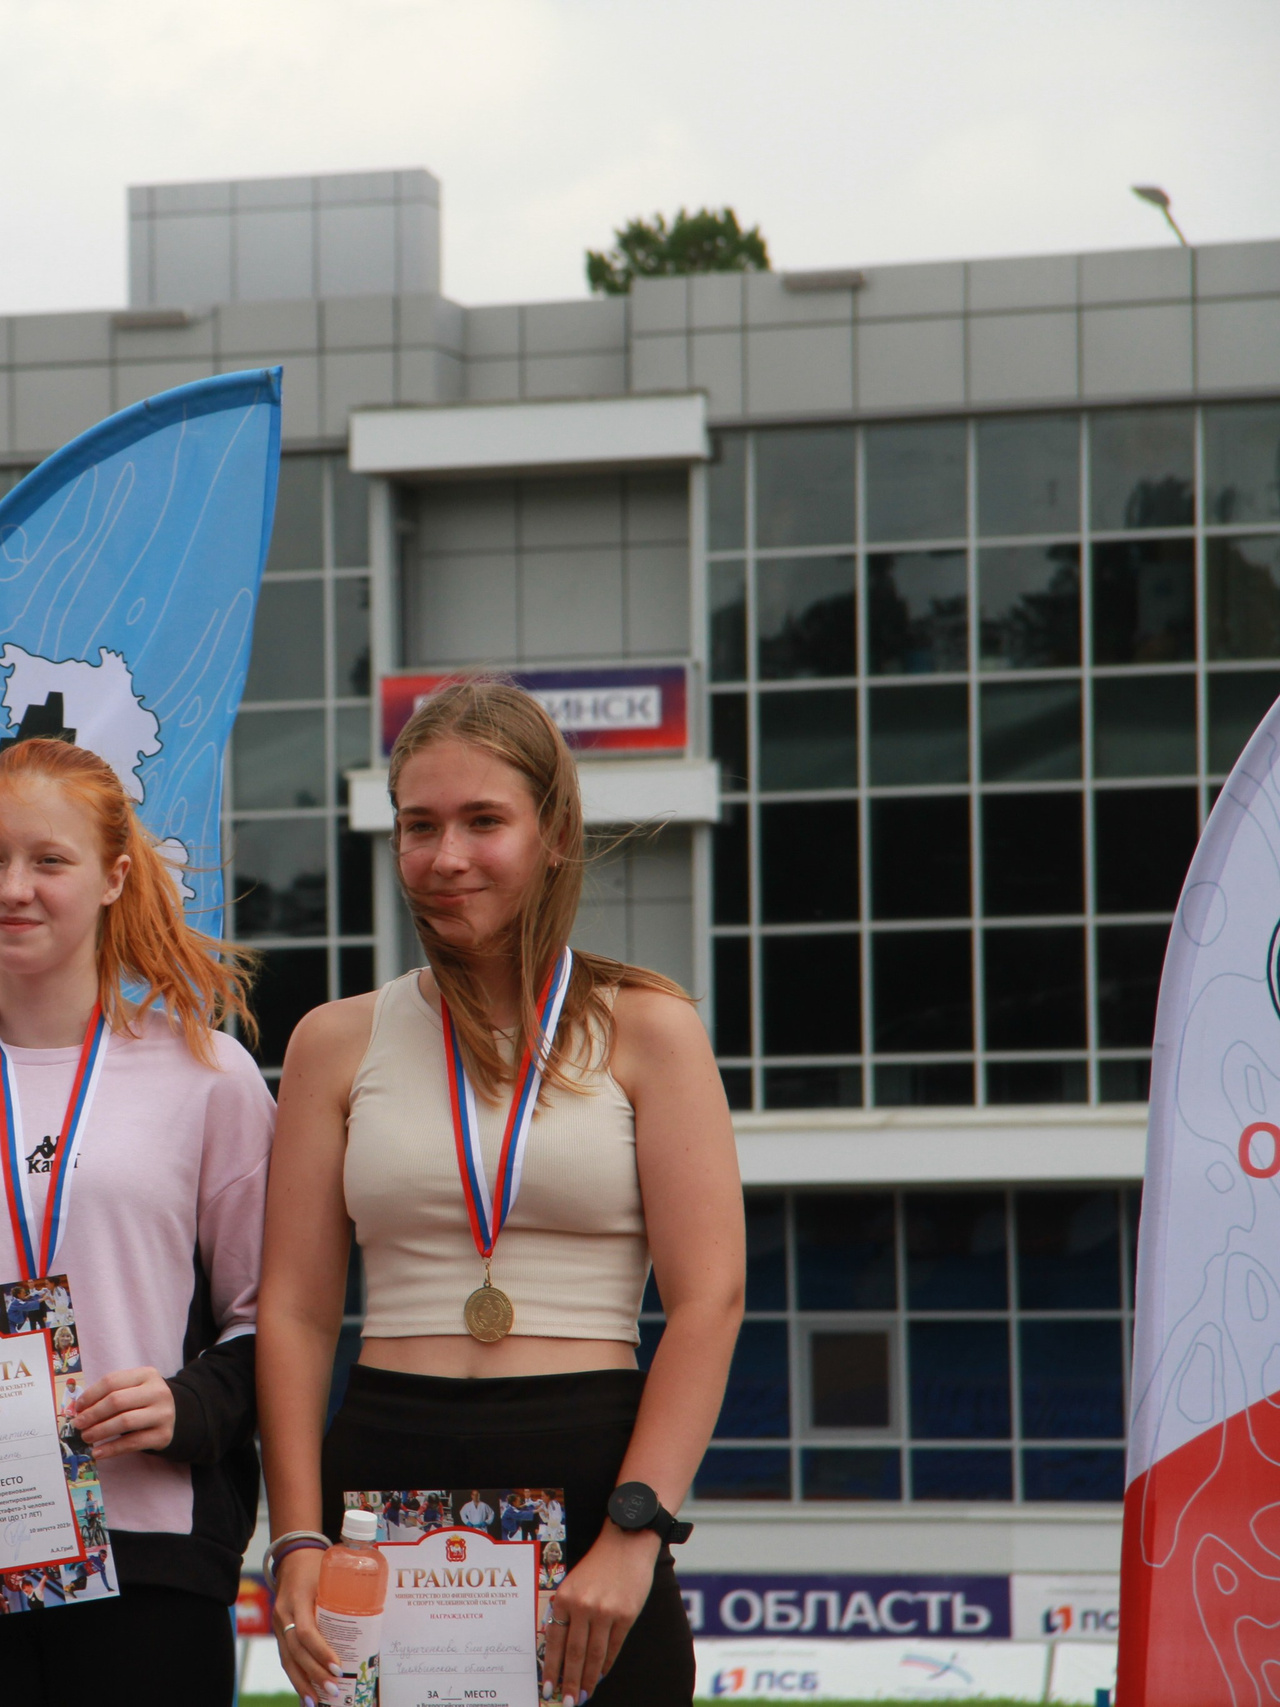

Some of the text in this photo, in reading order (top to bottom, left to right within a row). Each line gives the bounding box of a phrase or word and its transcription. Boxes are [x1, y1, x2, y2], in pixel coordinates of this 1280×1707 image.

[5, 1381, 35, 1391] КУЛЬТУРЕ
[27, 1501, 55, 1509] человека
[8, 1514, 19, 1523] (ДО
[28, 1510, 42, 1519] ЛЕТ)
[36, 1524, 56, 1533] августа
[395, 1567, 518, 1588] ГРАМОТА
[719, 1590, 993, 1633] ОБЛАСТЬ
[752, 1670, 819, 1693] ПСБ
[427, 1690, 439, 1698] ЗА
[464, 1690, 497, 1698] МЕСТО
